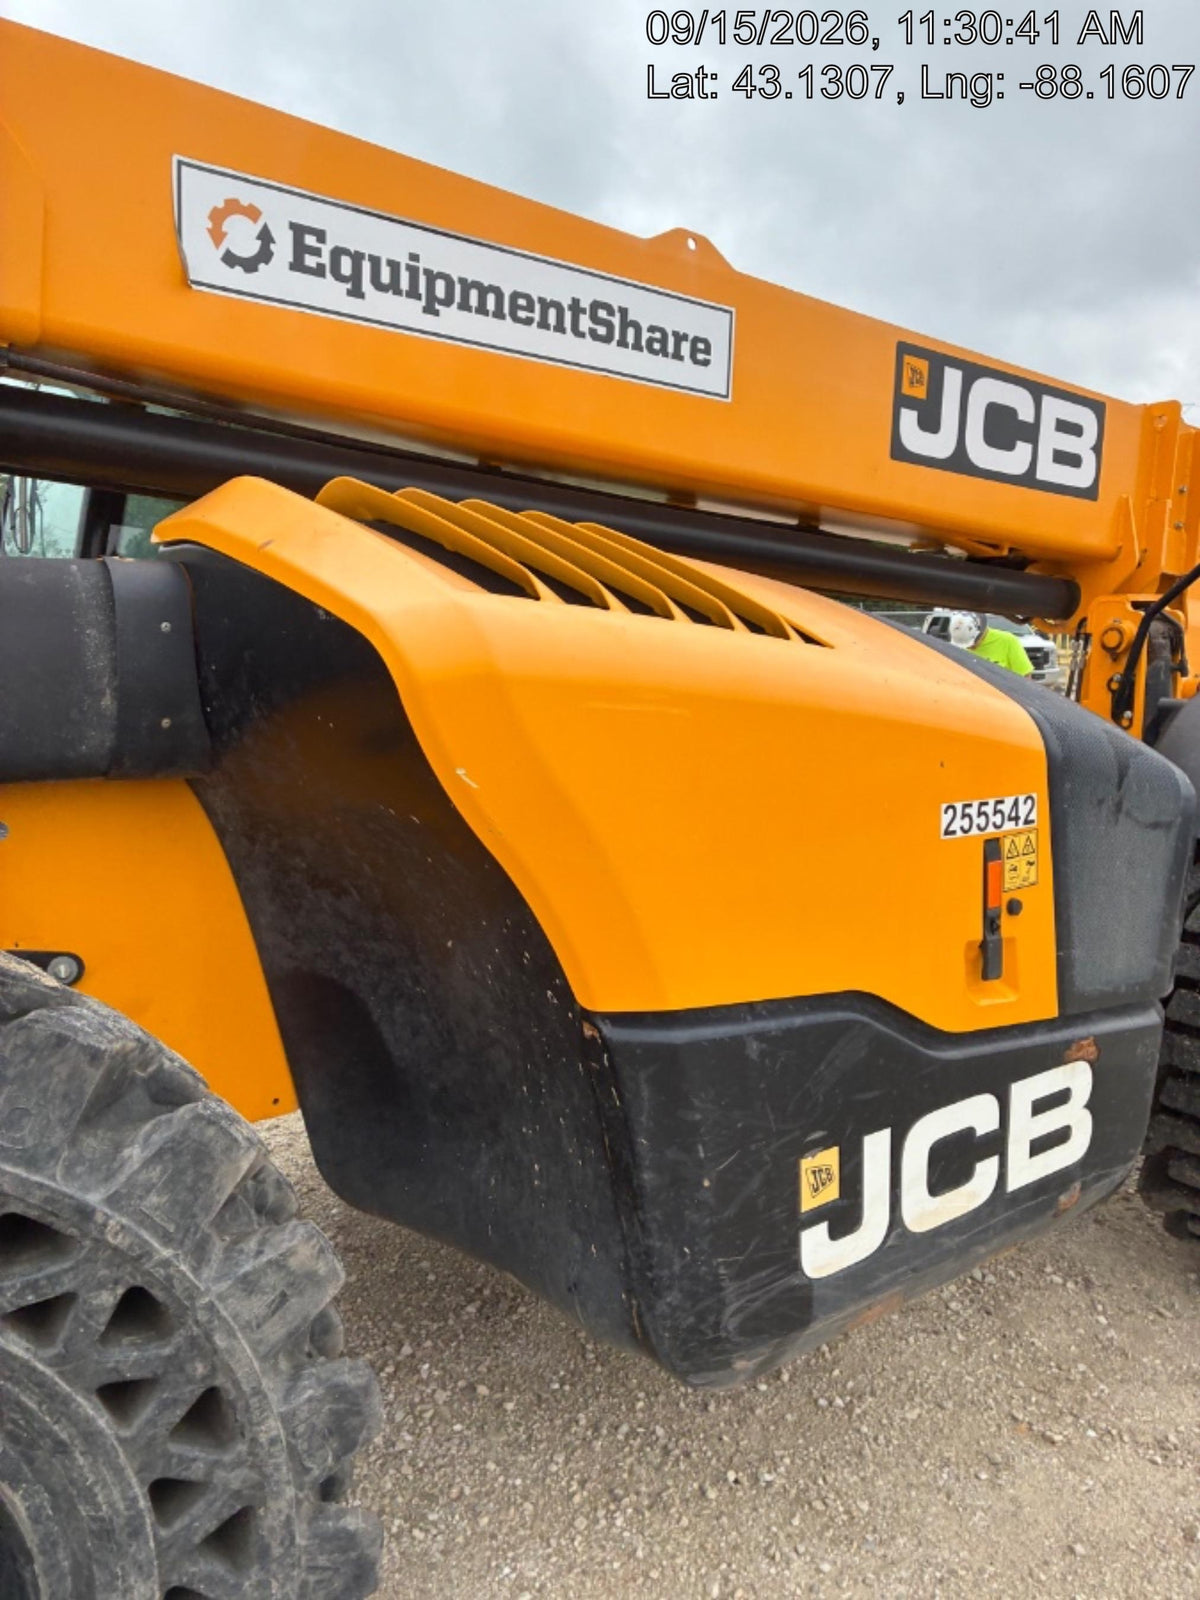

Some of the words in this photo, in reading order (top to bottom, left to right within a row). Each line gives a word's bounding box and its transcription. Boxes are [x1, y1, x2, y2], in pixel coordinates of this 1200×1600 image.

[288, 221, 712, 368] EquipmentShare
[899, 365, 1098, 489] JCB
[943, 794, 1036, 836] 255542
[800, 1060, 1093, 1279] JCB
[809, 1167, 834, 1193] JCB
